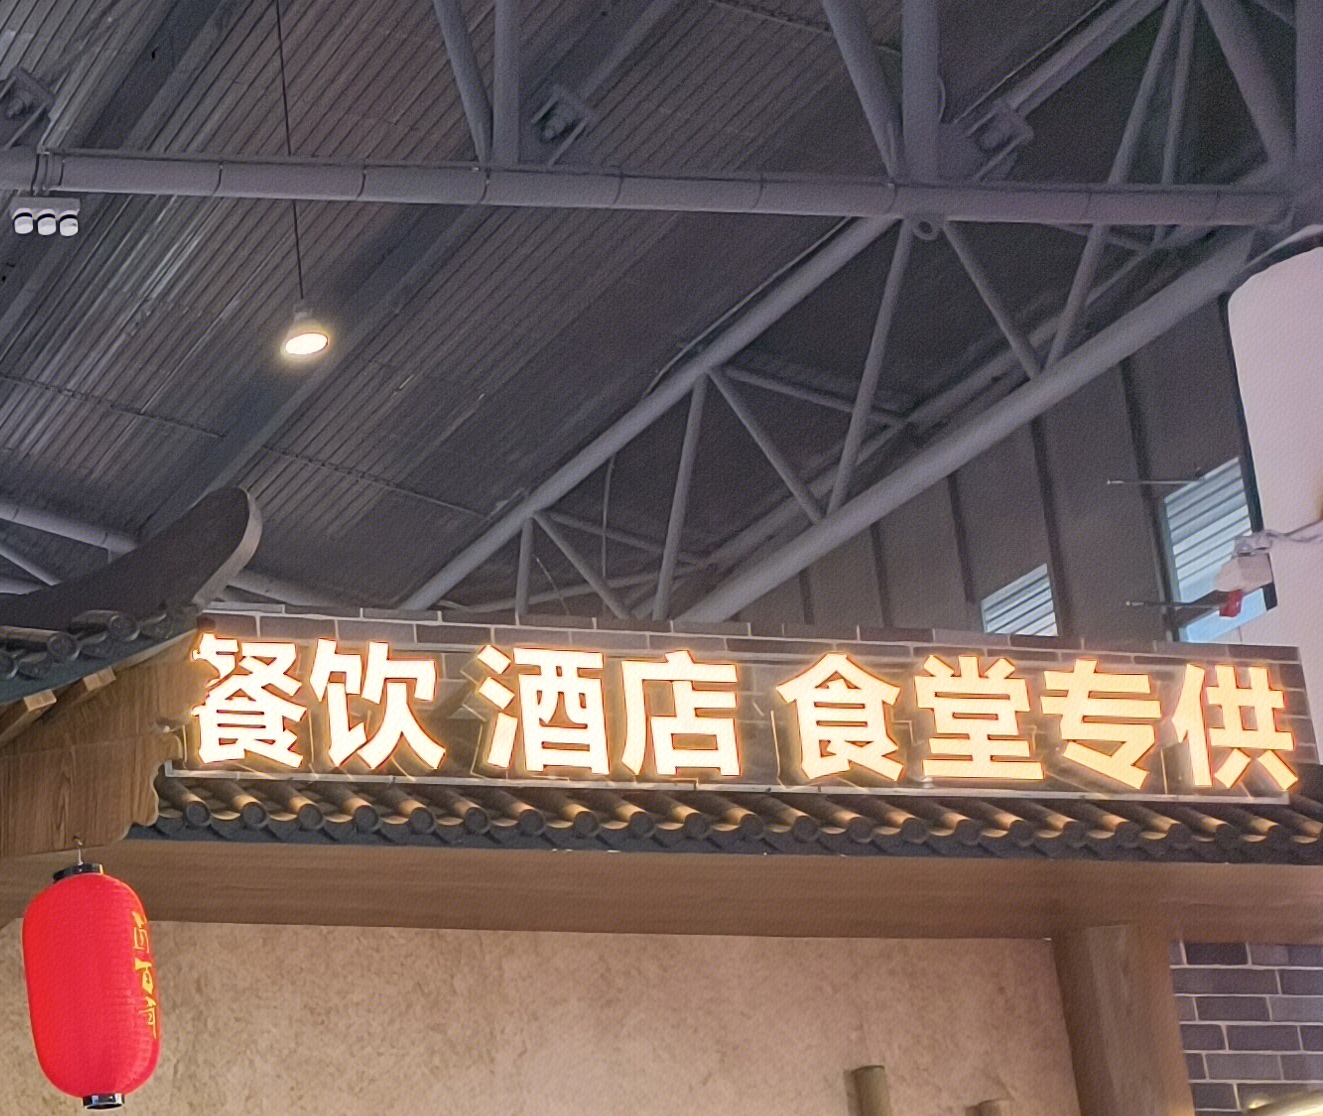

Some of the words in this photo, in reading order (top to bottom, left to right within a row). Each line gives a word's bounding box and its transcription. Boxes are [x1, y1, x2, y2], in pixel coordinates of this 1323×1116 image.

[191, 631, 448, 771] 餐饮
[475, 644, 742, 779] 酒店
[774, 650, 1299, 792] 食堂专供
